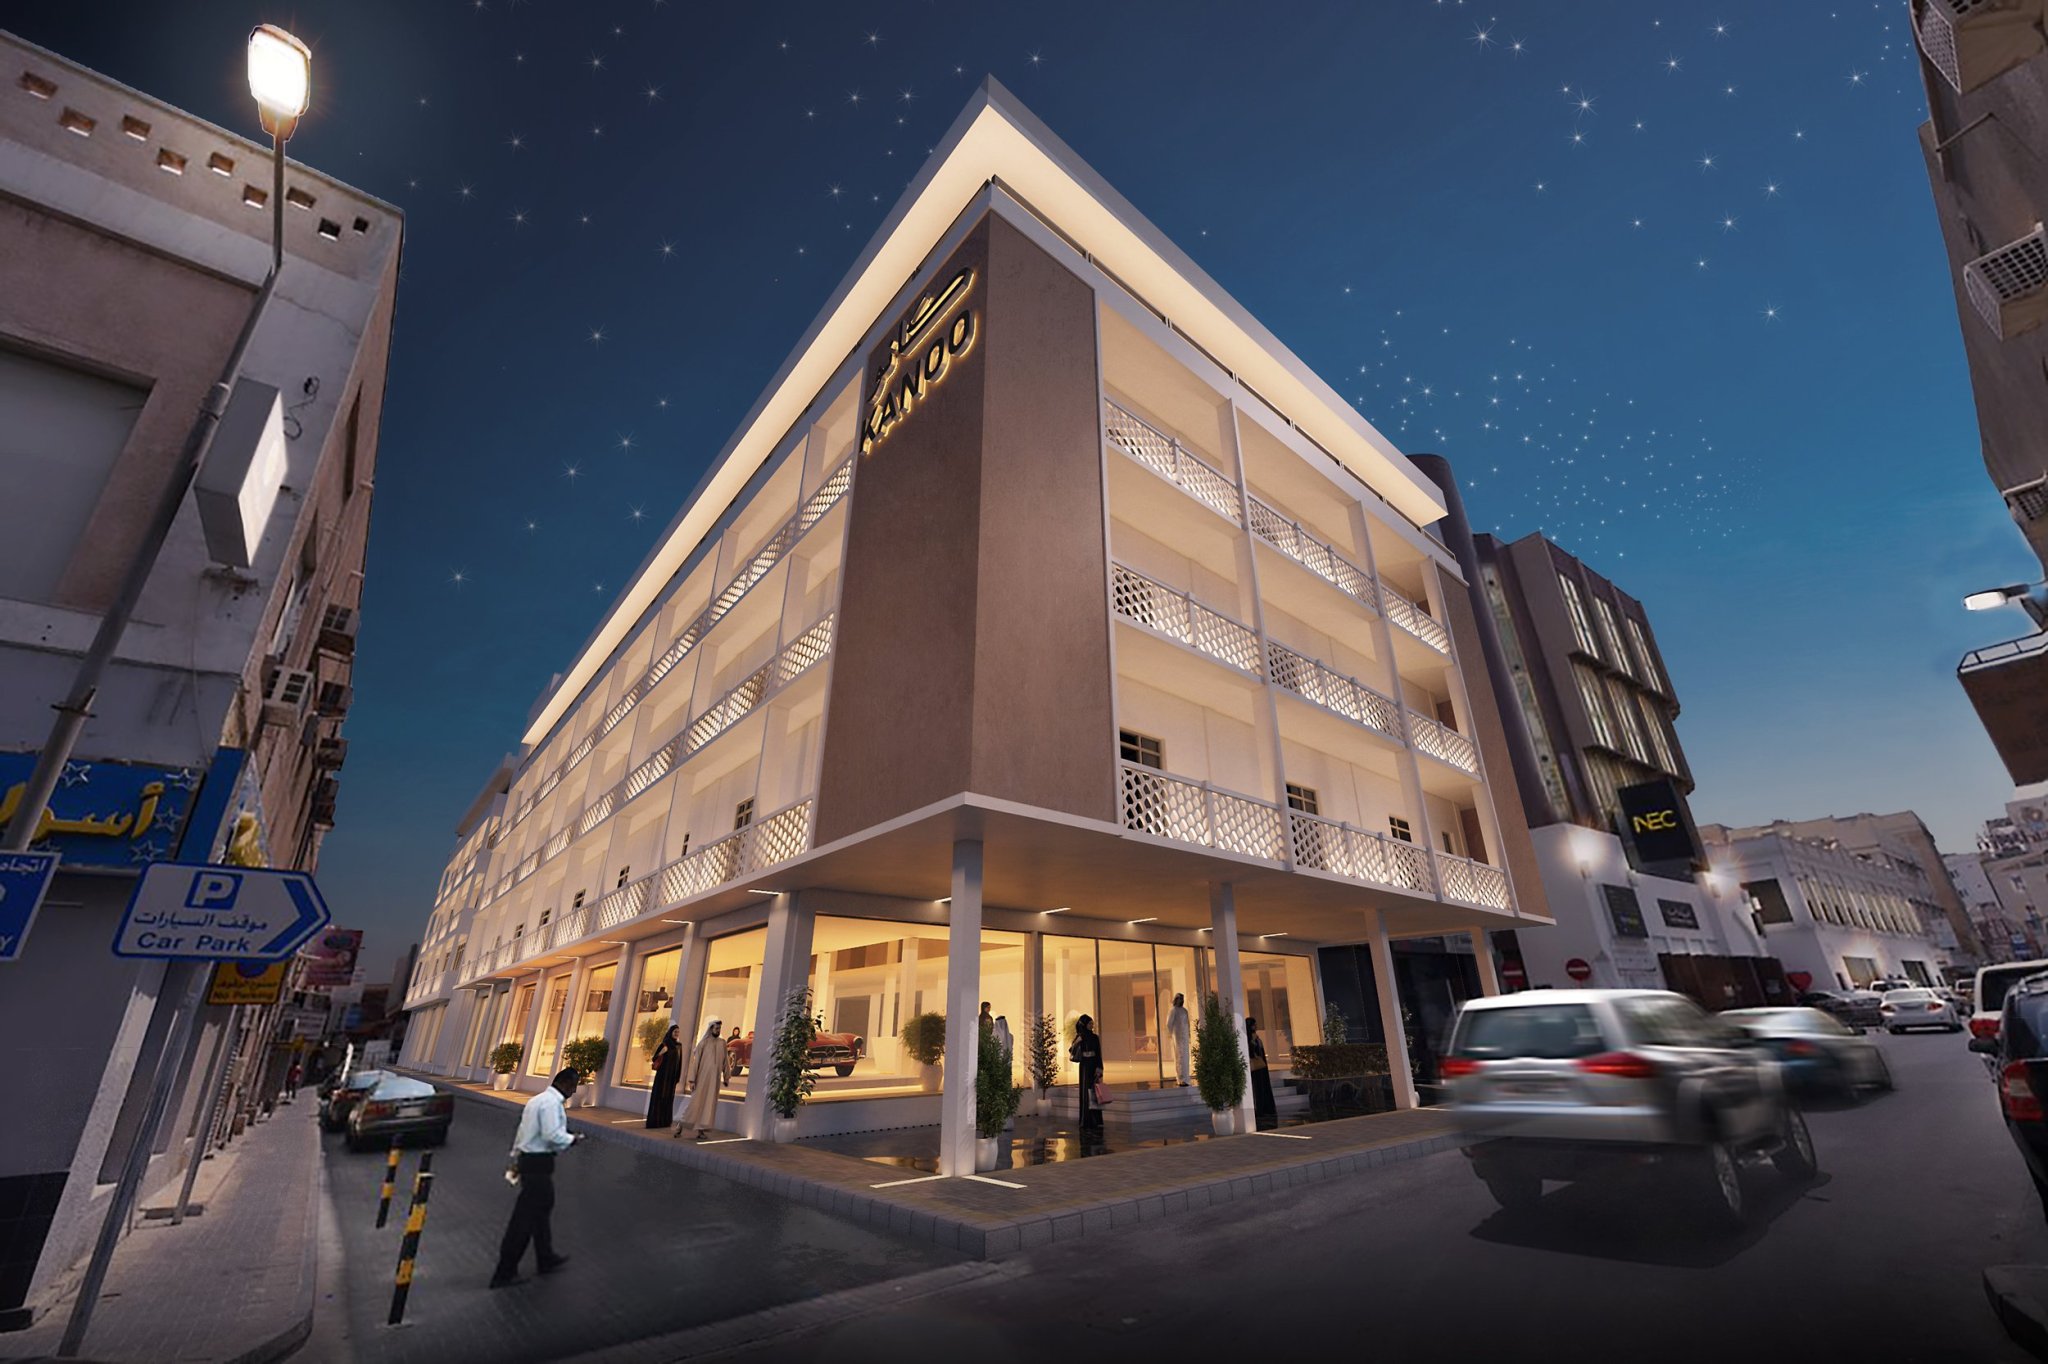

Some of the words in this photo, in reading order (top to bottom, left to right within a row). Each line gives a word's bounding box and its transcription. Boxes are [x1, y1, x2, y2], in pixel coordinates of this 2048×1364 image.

[859, 309, 979, 457] KANOO
[1632, 809, 1678, 833] NEC
[190, 873, 235, 907] P
[134, 910, 215, 930] السيارات
[217, 913, 268, 933] موقف
[138, 931, 185, 950] Car
[196, 934, 251, 953] Park
